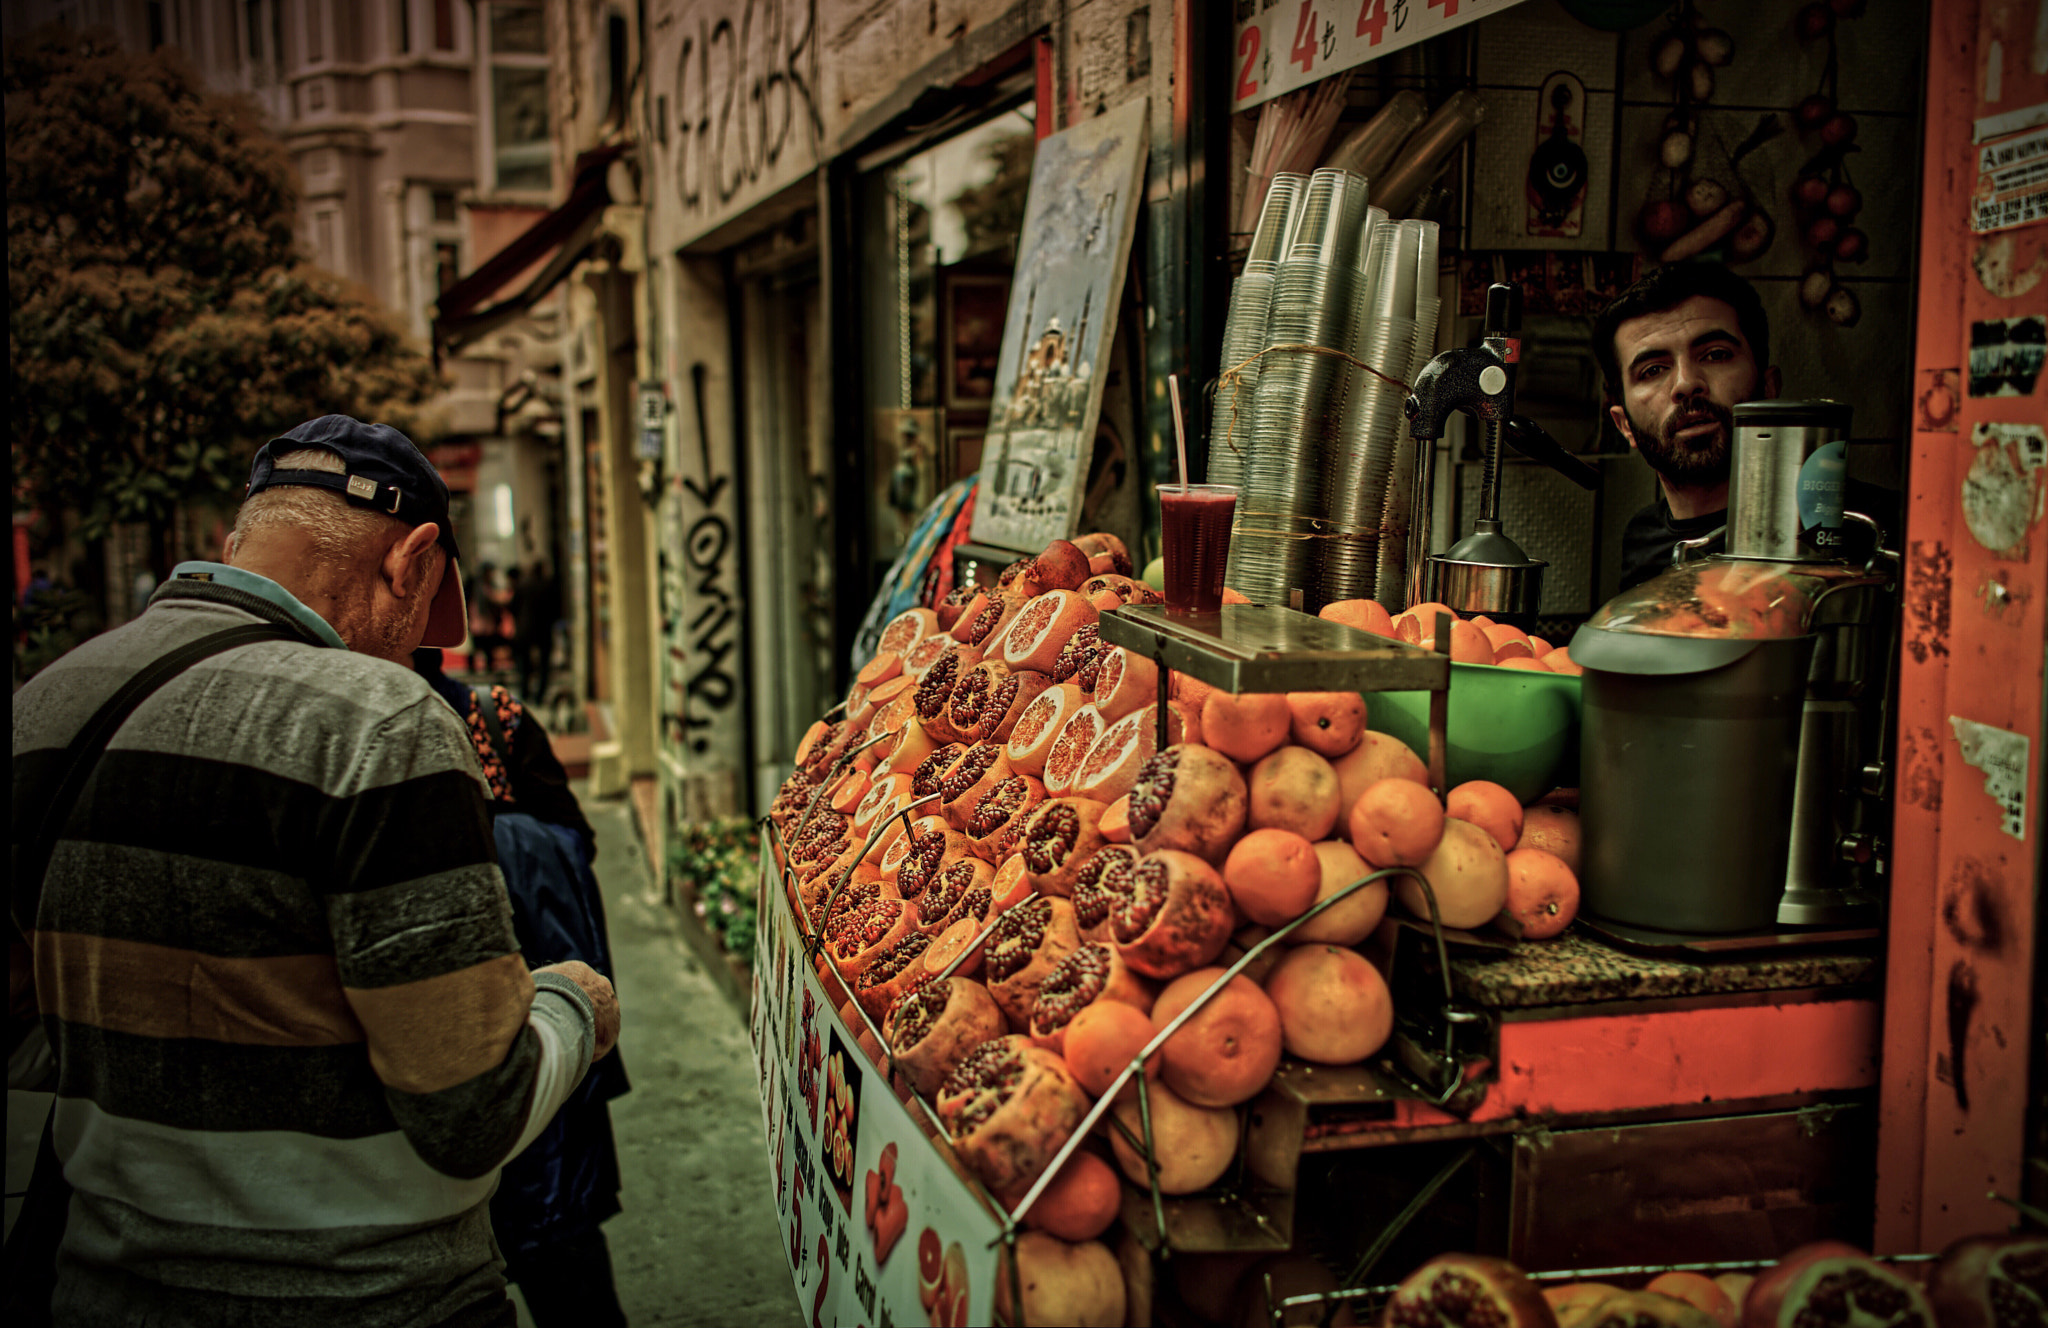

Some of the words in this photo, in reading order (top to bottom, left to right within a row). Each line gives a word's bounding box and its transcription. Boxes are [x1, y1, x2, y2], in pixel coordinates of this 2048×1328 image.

[1236, 25, 1261, 101] 2
[1290, 0, 1318, 74] 4
[790, 1160, 805, 1271] 5
[818, 1174, 834, 1237] Orange
[836, 1213, 850, 1273] juice
[812, 1233, 830, 1328] 2
[855, 1251, 877, 1326] Carrot
